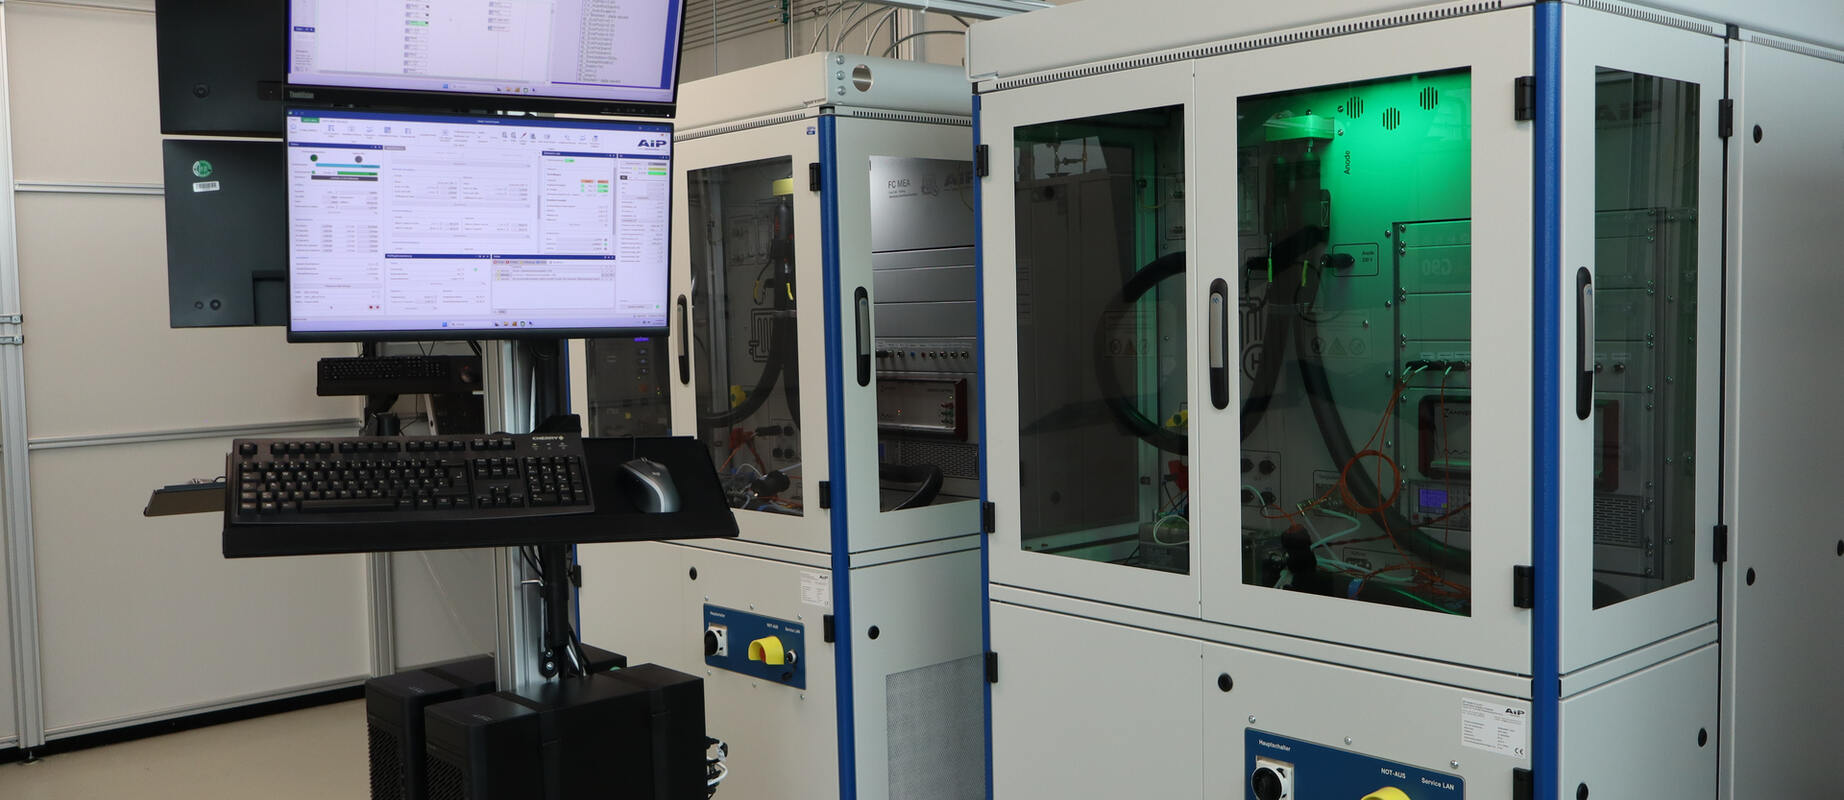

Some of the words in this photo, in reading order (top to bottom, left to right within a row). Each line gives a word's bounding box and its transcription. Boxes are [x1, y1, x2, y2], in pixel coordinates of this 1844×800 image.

[638, 139, 667, 147] AiP
[888, 180, 896, 188] FC
[897, 179, 911, 187] MEA
[1505, 707, 1525, 716] AiP
[1258, 739, 1291, 752] Hauptschalter
[1381, 767, 1406, 779] NOT-AUS
[1421, 777, 1440, 788] Service
[1441, 782, 1455, 791] LAN
